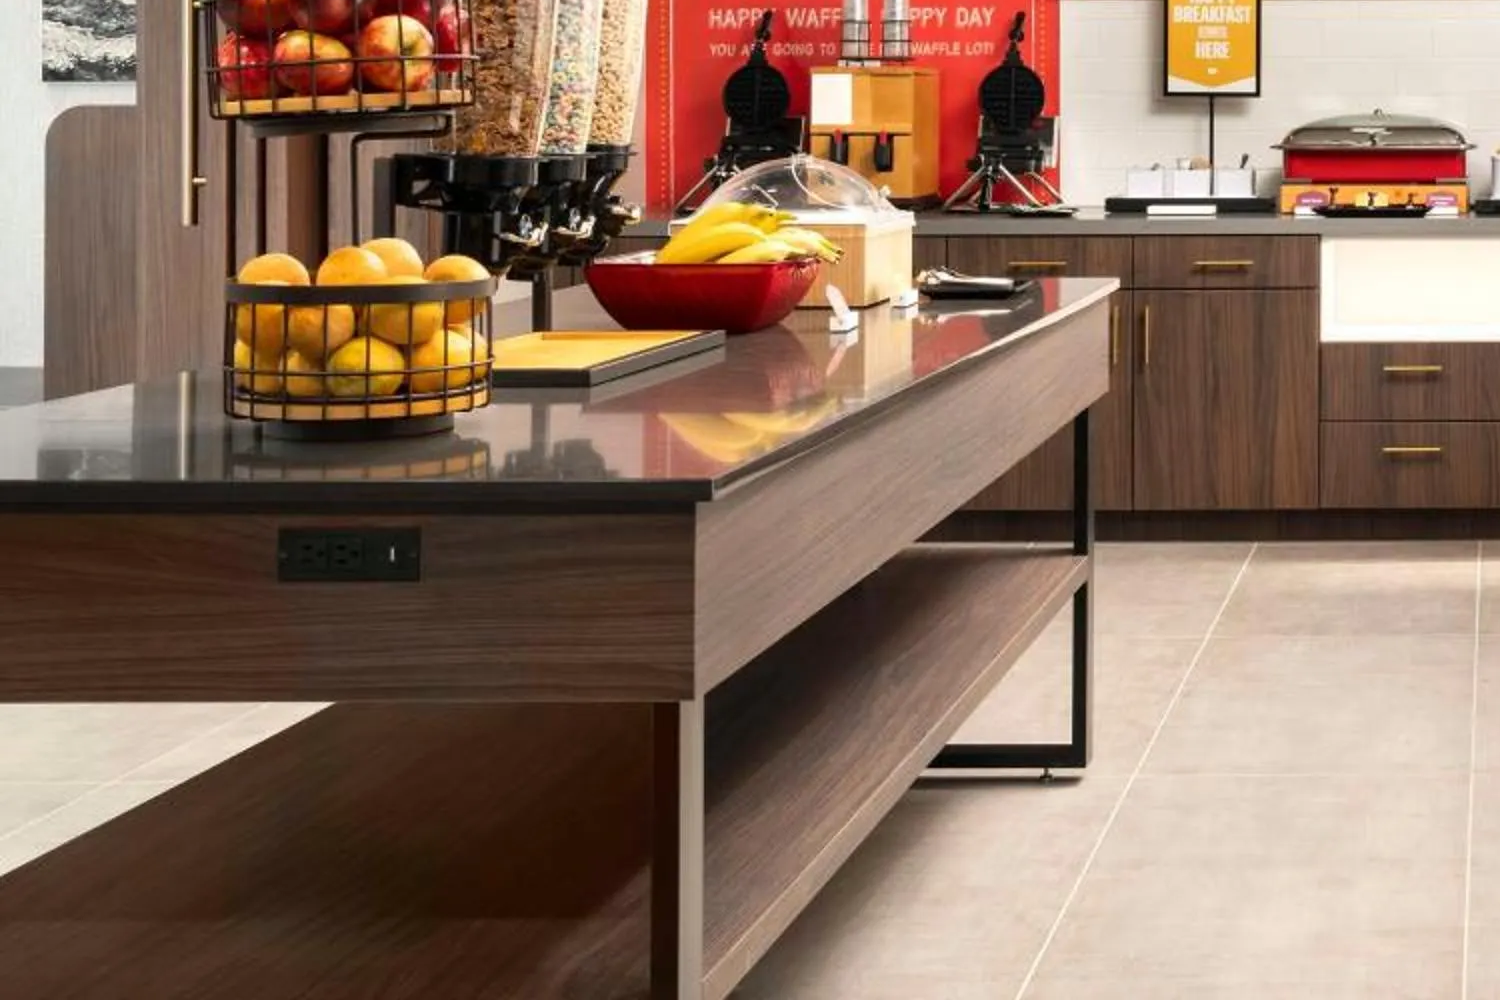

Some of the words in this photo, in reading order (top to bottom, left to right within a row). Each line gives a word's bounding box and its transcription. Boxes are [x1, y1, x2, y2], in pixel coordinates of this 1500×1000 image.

[708, 7, 776, 29] HAPP
[954, 7, 996, 28] DAY
[709, 43, 737, 57] YOU
[772, 42, 815, 56] GOING
[820, 43, 837, 56] TO
[910, 41, 961, 55] WAFFLE
